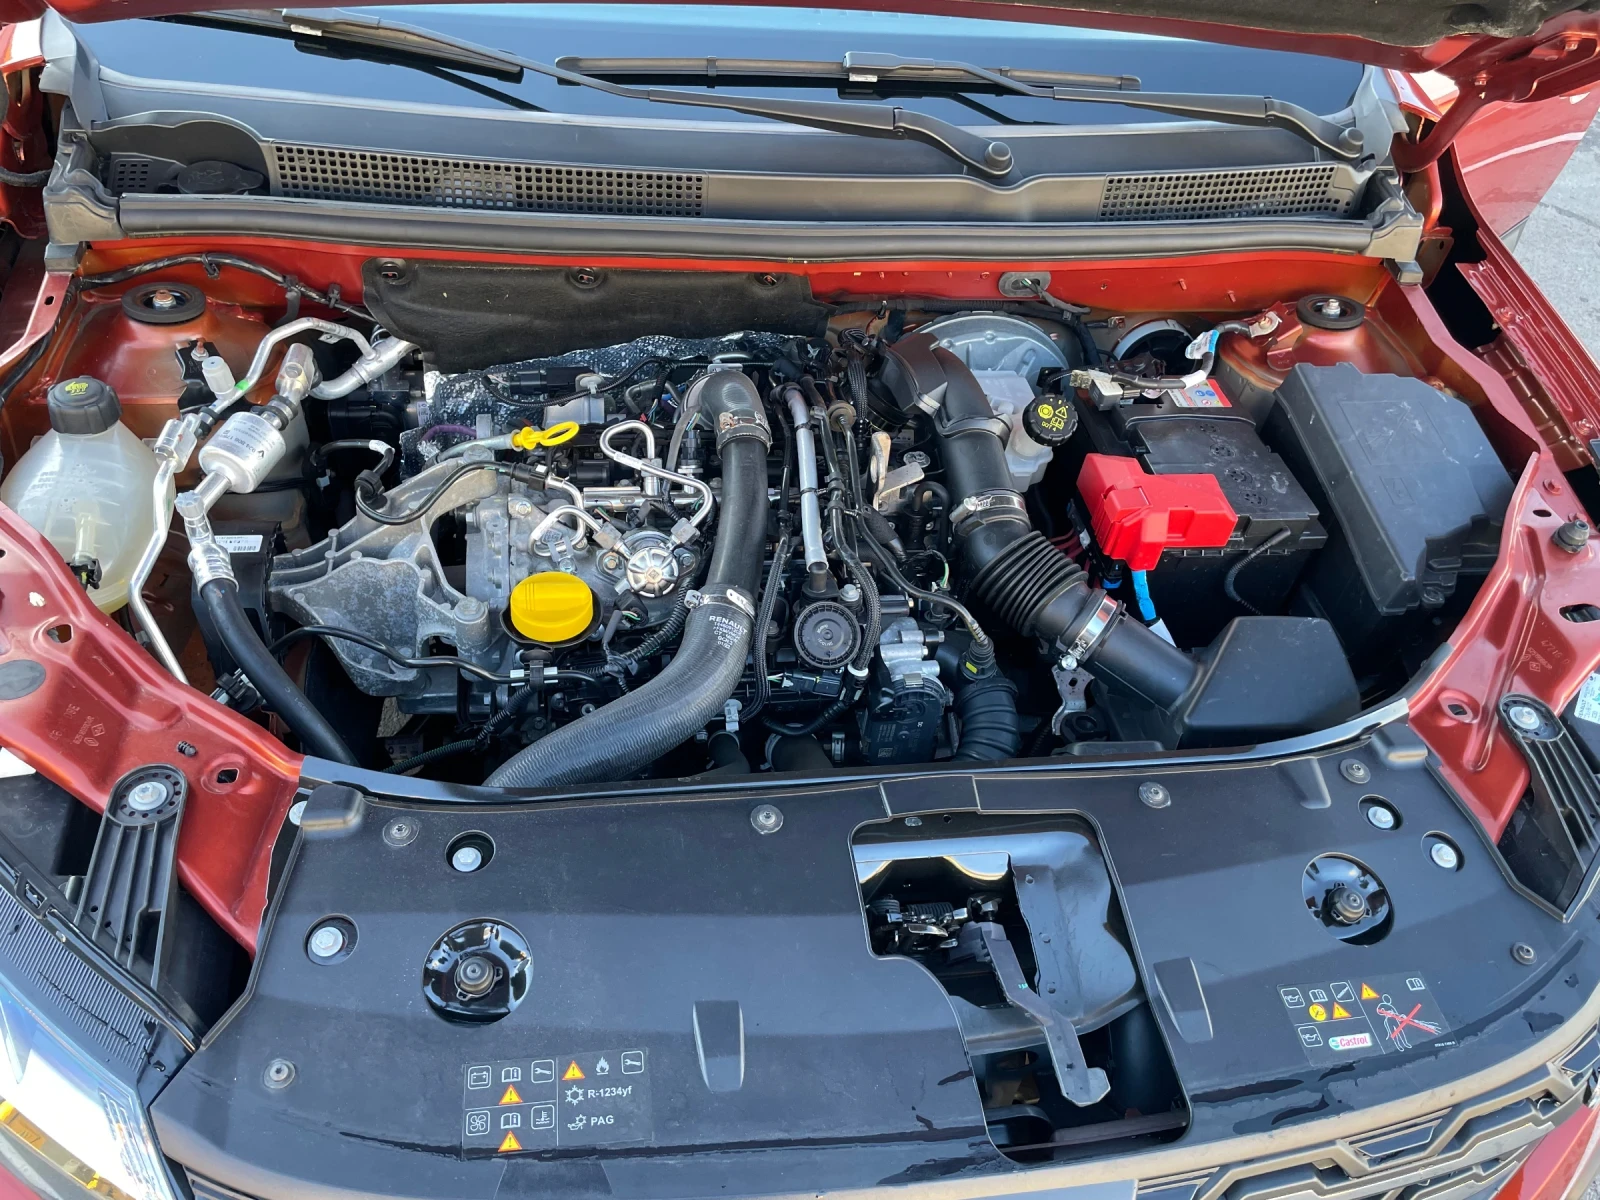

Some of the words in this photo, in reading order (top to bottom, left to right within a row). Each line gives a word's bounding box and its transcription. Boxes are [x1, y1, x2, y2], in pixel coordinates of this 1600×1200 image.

[708, 615, 748, 635] RENAULT
[1339, 1034, 1369, 1048] Castrol
[587, 1086, 633, 1101] R-1234yf
[590, 1114, 615, 1127] PAG
